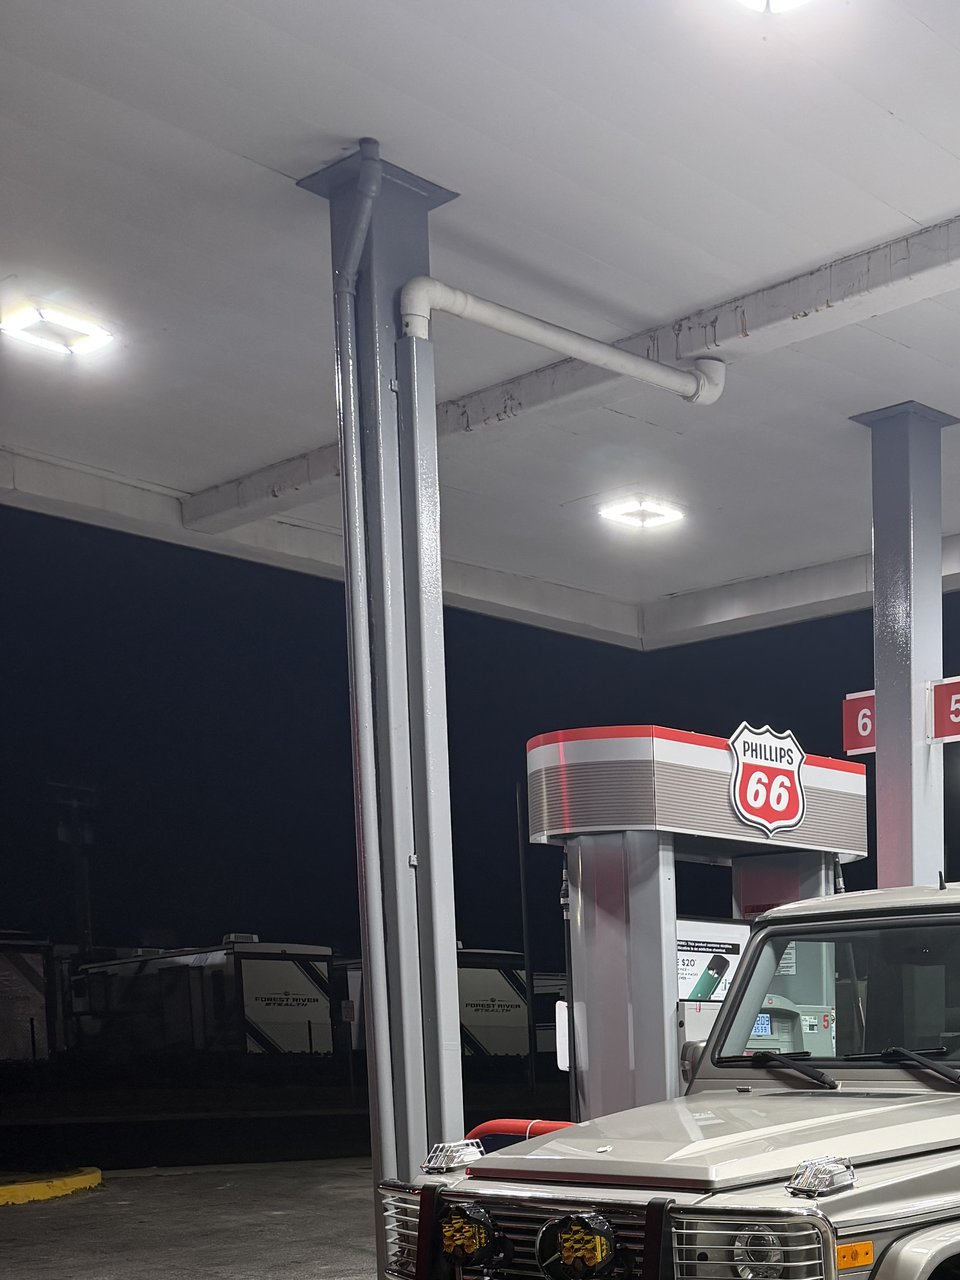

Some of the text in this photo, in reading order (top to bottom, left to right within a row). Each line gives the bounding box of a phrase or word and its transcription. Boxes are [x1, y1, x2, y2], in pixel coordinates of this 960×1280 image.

[857, 708, 872, 737] 6
[742, 740, 794, 765] PHILLIPS
[746, 771, 791, 812] 66
[822, 1014, 830, 1029] 5
